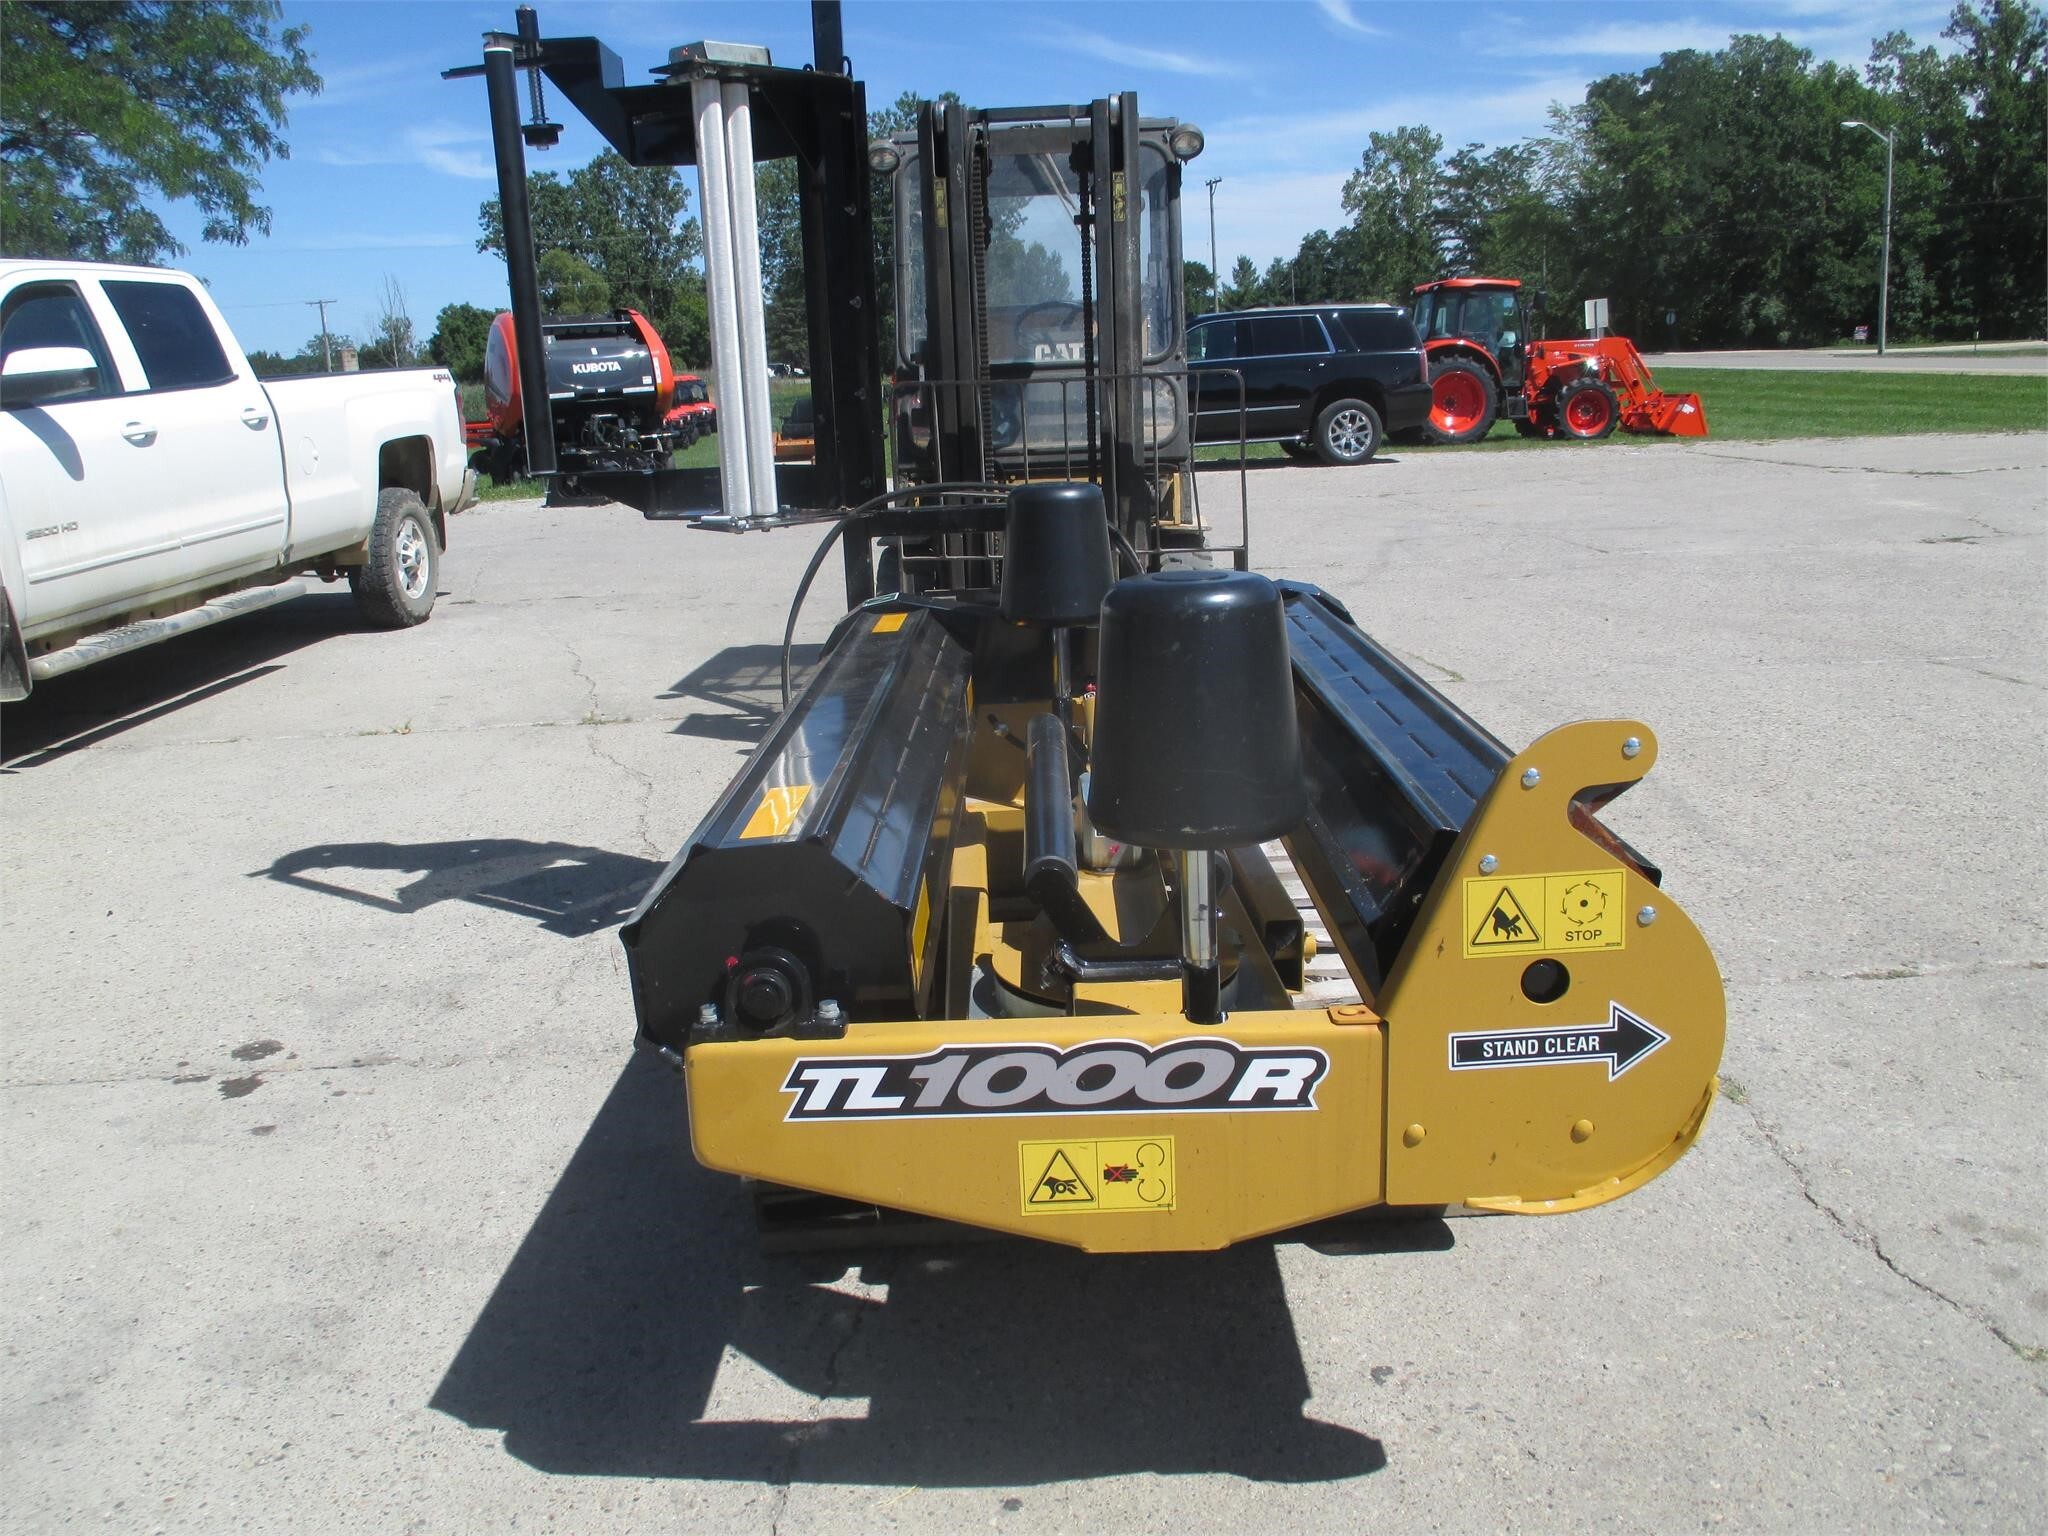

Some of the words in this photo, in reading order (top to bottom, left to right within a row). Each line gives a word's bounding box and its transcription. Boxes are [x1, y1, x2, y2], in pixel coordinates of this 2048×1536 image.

[1035, 343, 1084, 361] CAT
[572, 361, 622, 374] KUBOTA
[1565, 929, 1602, 941] STOP
[1482, 1039, 1539, 1058] STAND
[1544, 1035, 1600, 1054] CLEAR
[800, 1048, 1317, 1111] TL1000R
